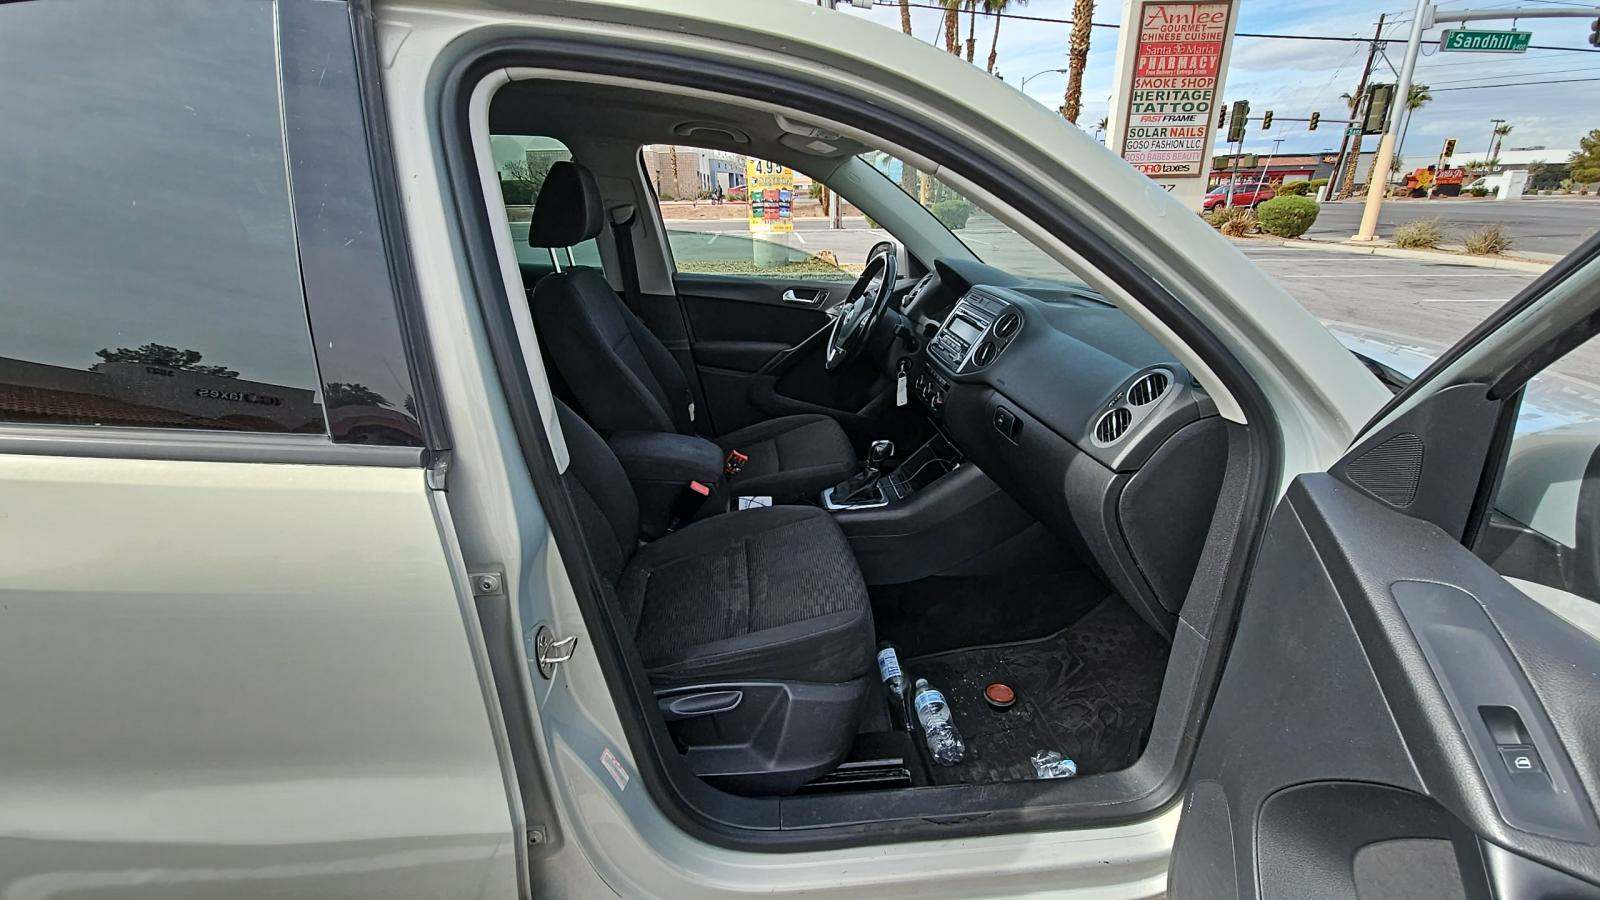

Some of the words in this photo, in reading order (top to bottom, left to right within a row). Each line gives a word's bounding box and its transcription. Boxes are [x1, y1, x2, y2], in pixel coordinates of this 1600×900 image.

[1145, 5, 1224, 27] Amlee
[1161, 24, 1207, 32] GOURMET
[1142, 33, 1182, 41] CHINESE
[1185, 32, 1222, 40] CUISINE
[1453, 33, 1513, 49] Sandhill
[1146, 45, 1171, 55] Santa
[1187, 44, 1214, 54] Maria
[1139, 56, 1217, 69] PHARMACY
[1136, 79, 1177, 88] SMOKE
[1181, 78, 1214, 88] SHOP
[1133, 91, 1212, 101] HERITAGE
[1132, 102, 1209, 112] TATTOO
[1129, 128, 1168, 137] SOLAR
[1170, 127, 1204, 137] NAILS
[1126, 140, 1150, 149] GOSO
[1151, 140, 1184, 149] FASHION
[1125, 153, 1146, 162] GOSO
[1147, 153, 1171, 161] BABES
[1172, 152, 1200, 160] BEAUTY
[1163, 164, 1190, 172] taxes
